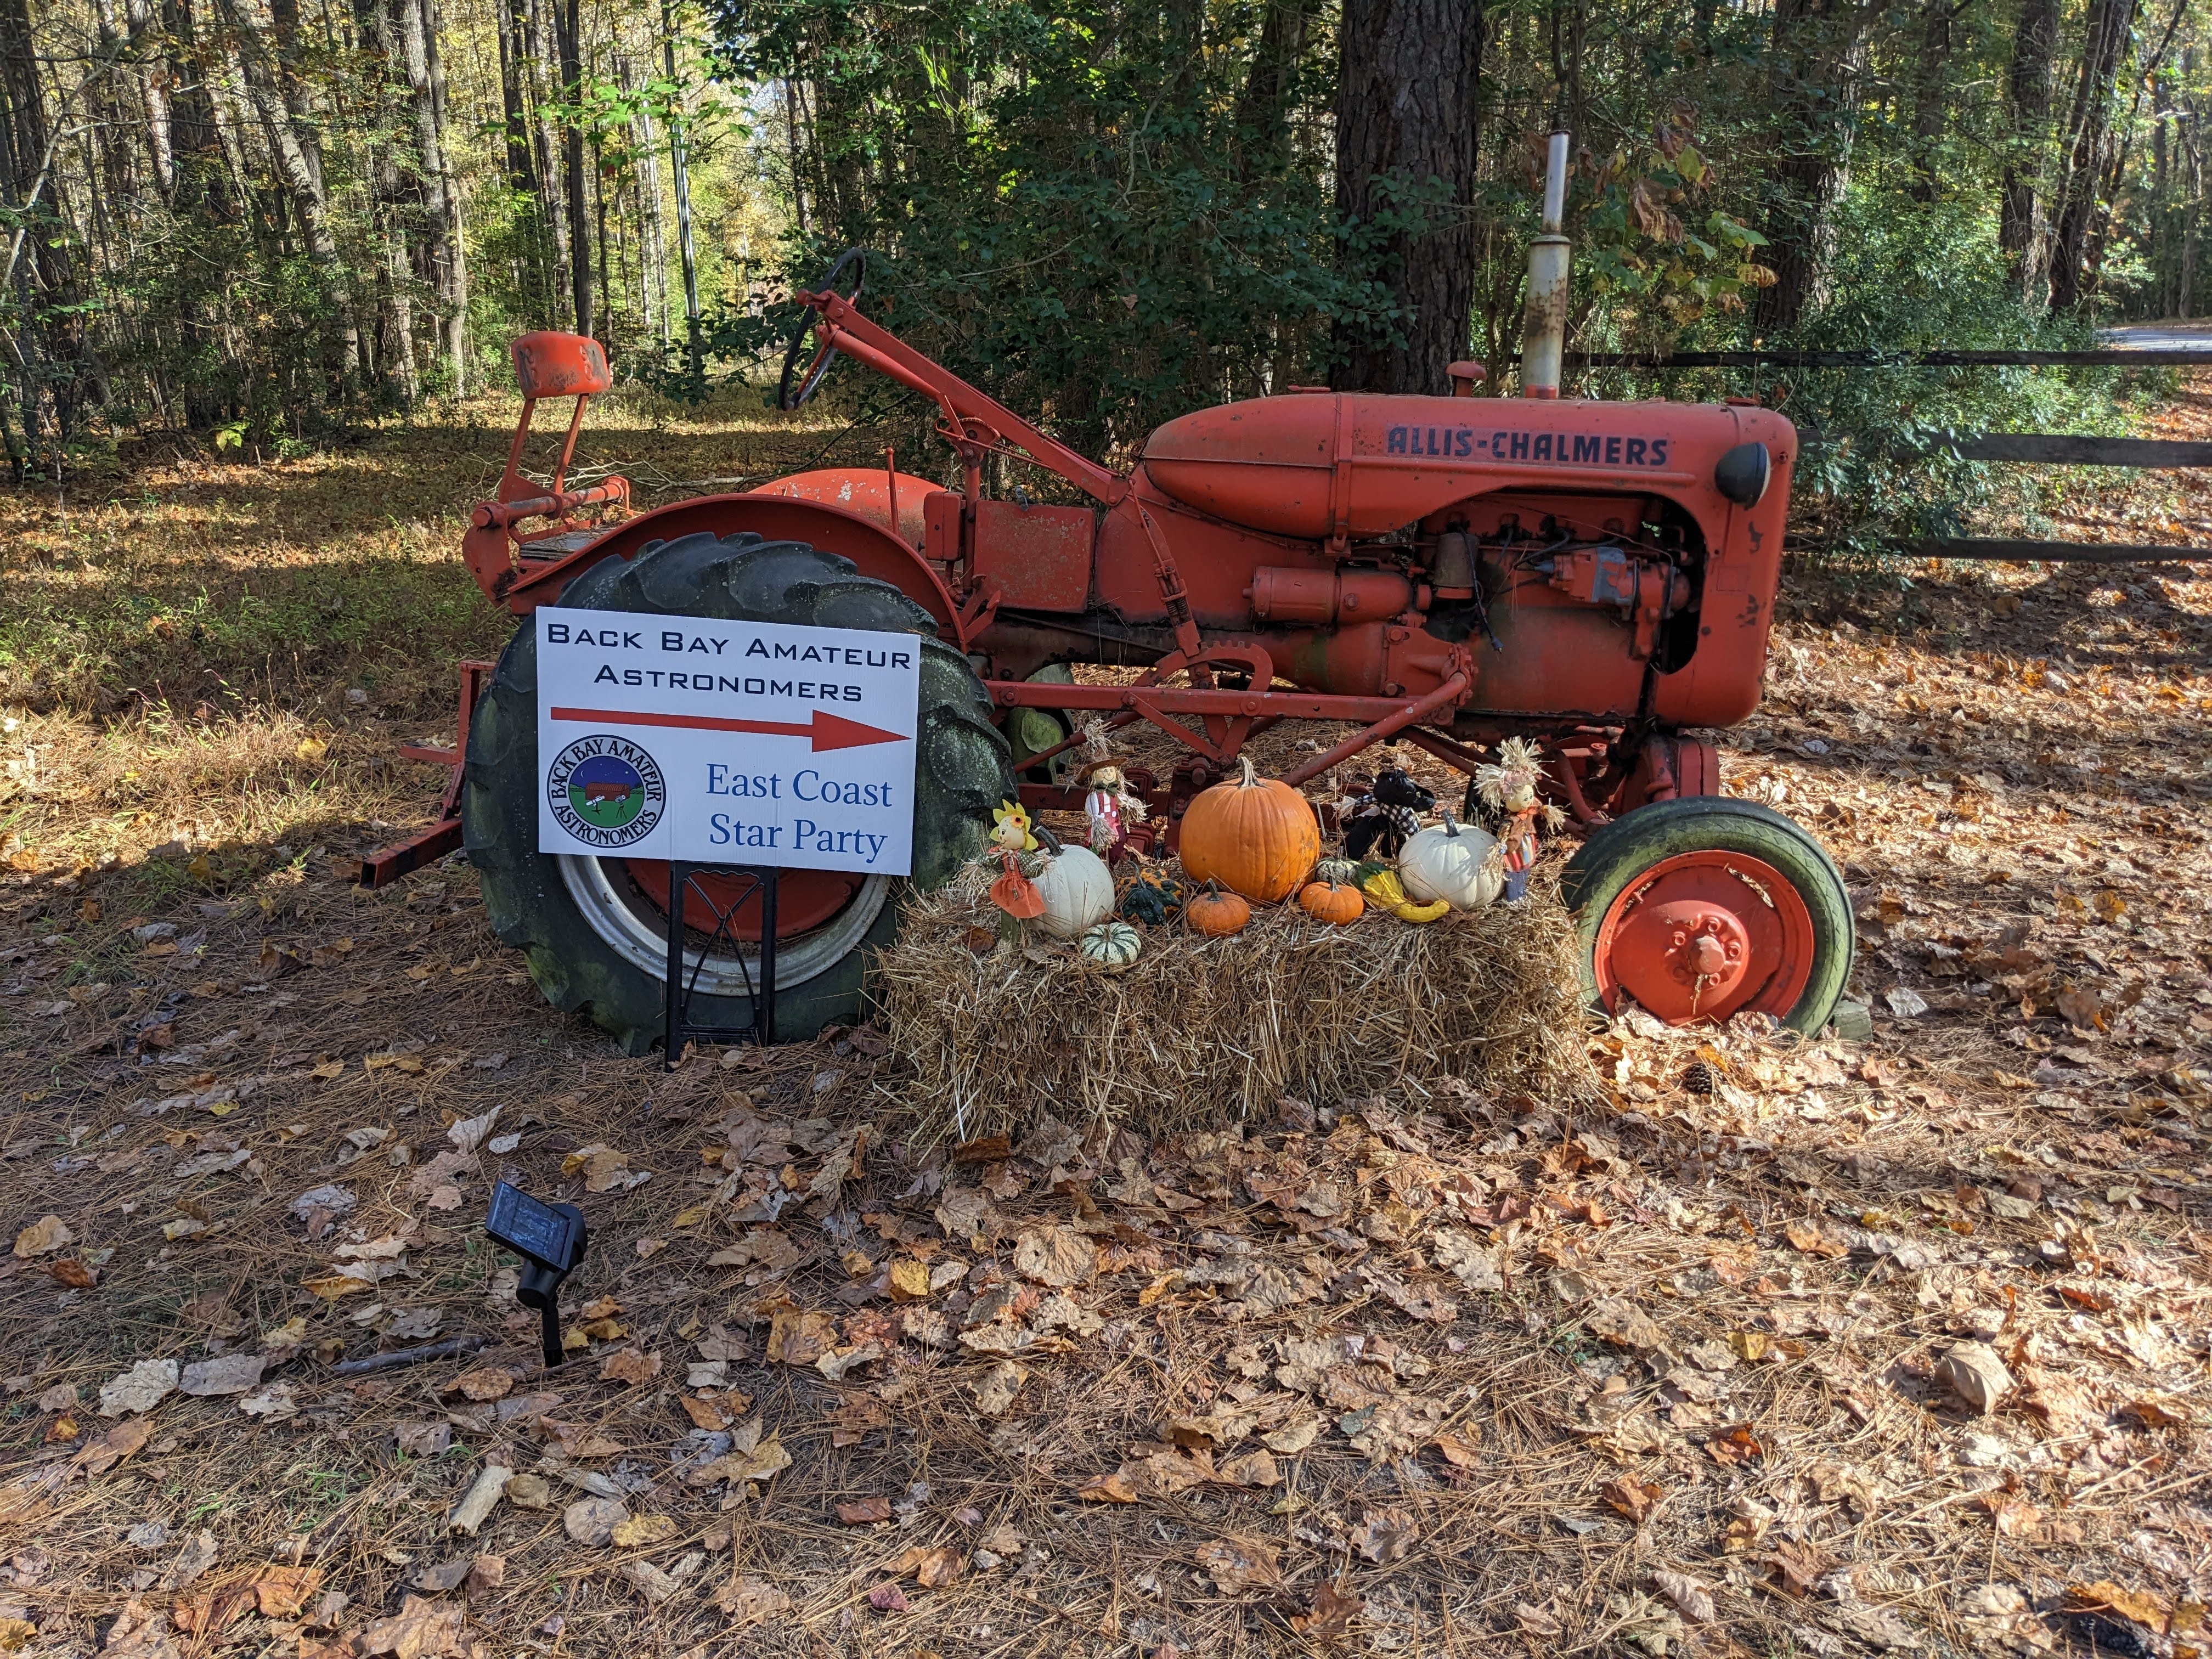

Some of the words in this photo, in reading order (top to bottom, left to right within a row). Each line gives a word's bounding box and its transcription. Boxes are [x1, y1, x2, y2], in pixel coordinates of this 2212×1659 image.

[1387, 426, 1668, 466] ALLIS-CHALMERS
[548, 623, 644, 650] BACK
[662, 631, 730, 655] BAY
[744, 638, 911, 670] AMATEUR
[593, 664, 862, 702] ASTRONOMERS
[551, 755, 578, 799] BACK
[571, 738, 603, 762] BAY
[607, 740, 662, 802] AMATEUR
[706, 763, 782, 799] East
[793, 770, 893, 808] Coast
[554, 805, 657, 845] ASTRONOMERS
[710, 813, 783, 848] Star
[792, 819, 888, 864] Party
